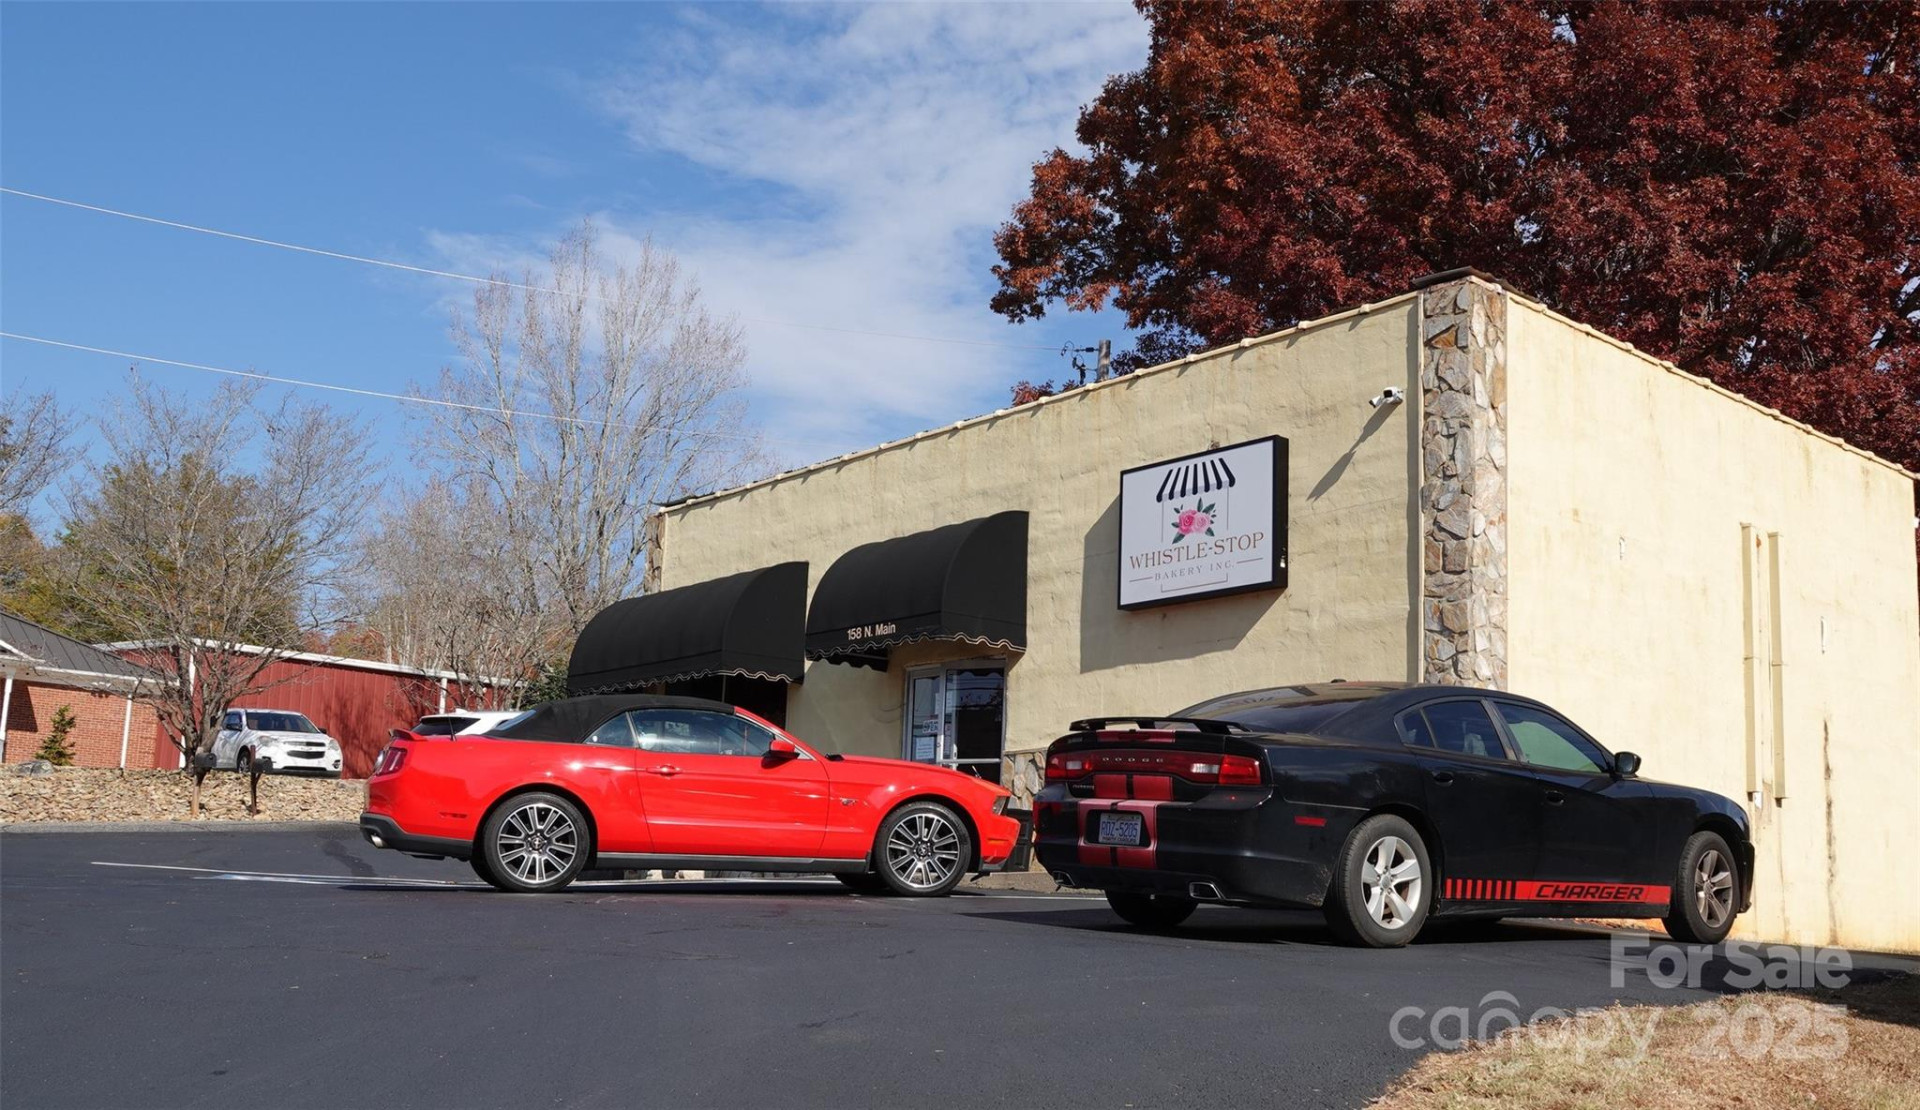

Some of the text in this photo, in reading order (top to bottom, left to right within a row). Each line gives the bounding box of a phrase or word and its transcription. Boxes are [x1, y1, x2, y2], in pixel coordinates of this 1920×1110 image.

[1129, 531, 1264, 569] WHISTLE-STOP
[1154, 565, 1202, 581] BAKERY
[847, 622, 896, 640] 158 N. Main
[1536, 884, 1645, 900] CHARGER
